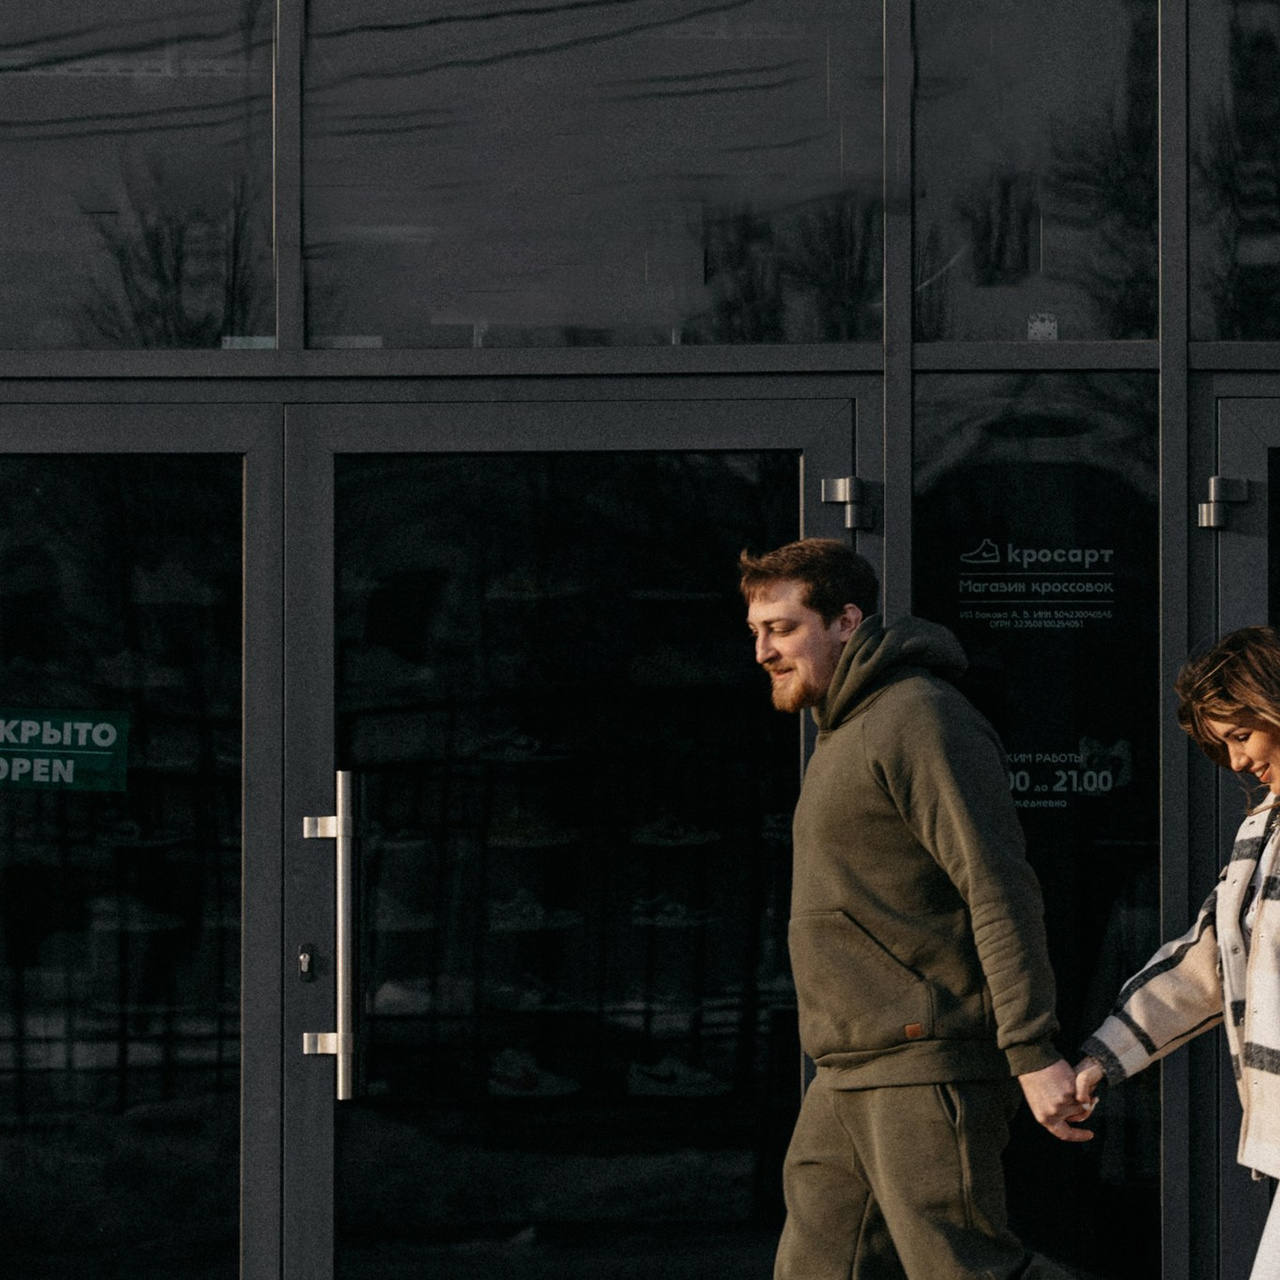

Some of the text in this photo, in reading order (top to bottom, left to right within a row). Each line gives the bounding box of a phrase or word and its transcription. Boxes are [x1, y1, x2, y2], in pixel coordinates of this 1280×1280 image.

[1007, 543, 1114, 569] кросарт
[959, 580, 1114, 595] Магазин кроссовок
[1036, 753, 1084, 763] РАБОТЫ
[1052, 770, 1113, 792] 21.00
[1013, 799, 1068, 808] жедневно
